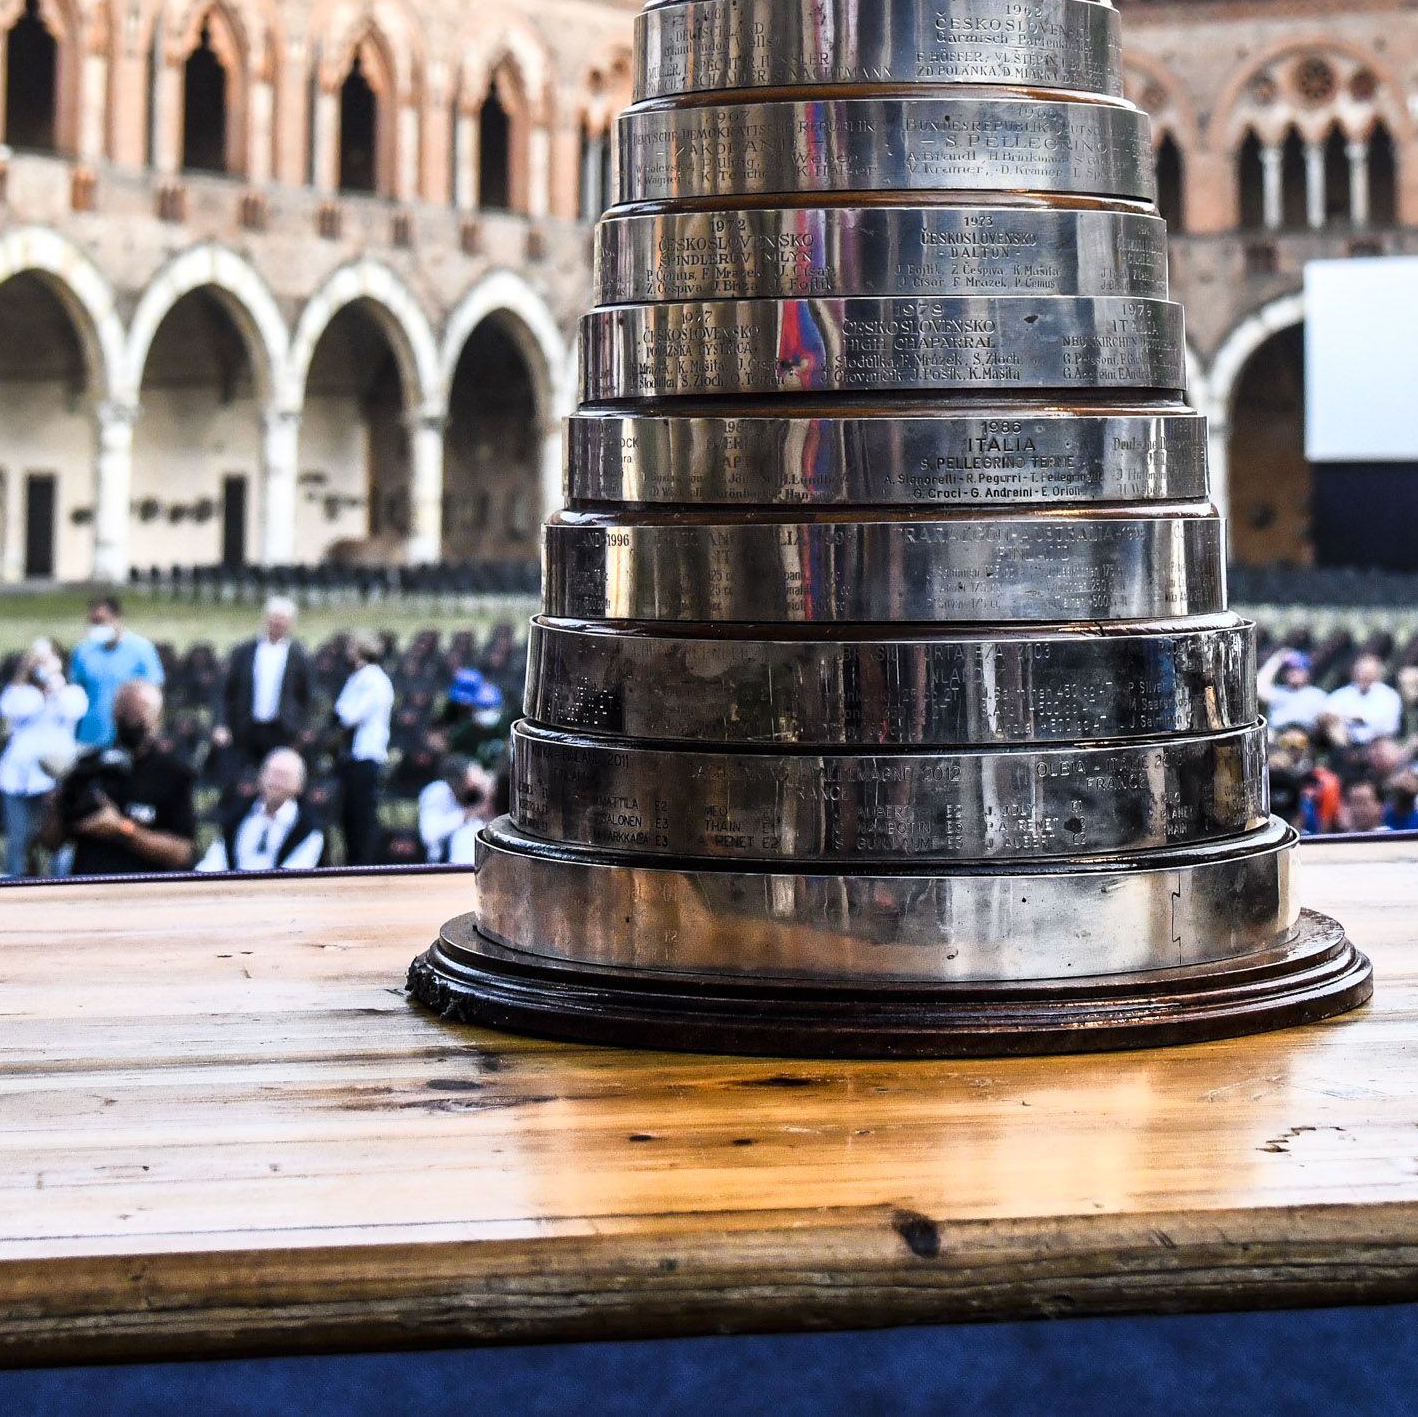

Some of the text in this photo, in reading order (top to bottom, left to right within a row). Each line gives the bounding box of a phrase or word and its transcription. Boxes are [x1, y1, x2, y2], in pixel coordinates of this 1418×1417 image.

[968, 134, 1109, 154] PELLEGRINO
[658, 232, 814, 253] ČESKOSLOVENSKO
[921, 227, 1039, 247] ČESKOSLOVENSKO
[842, 317, 996, 336] ČESKOSLOVENSKO
[894, 336, 997, 352] CHAPARRAL
[983, 421, 1023, 436] 1986
[967, 437, 1038, 453] ITALIA
[937, 456, 1026, 471] PELLEGRINO
[1030, 454, 1077, 469] TERME
[984, 486, 1033, 499] Andreini
[607, 753, 630, 768] 2011
[1036, 759, 1086, 778] OLBIA
[922, 766, 962, 782] 2012
[1085, 775, 1149, 792] FRANCE
[656, 818, 670, 830] E3
[656, 835, 670, 848] E3
